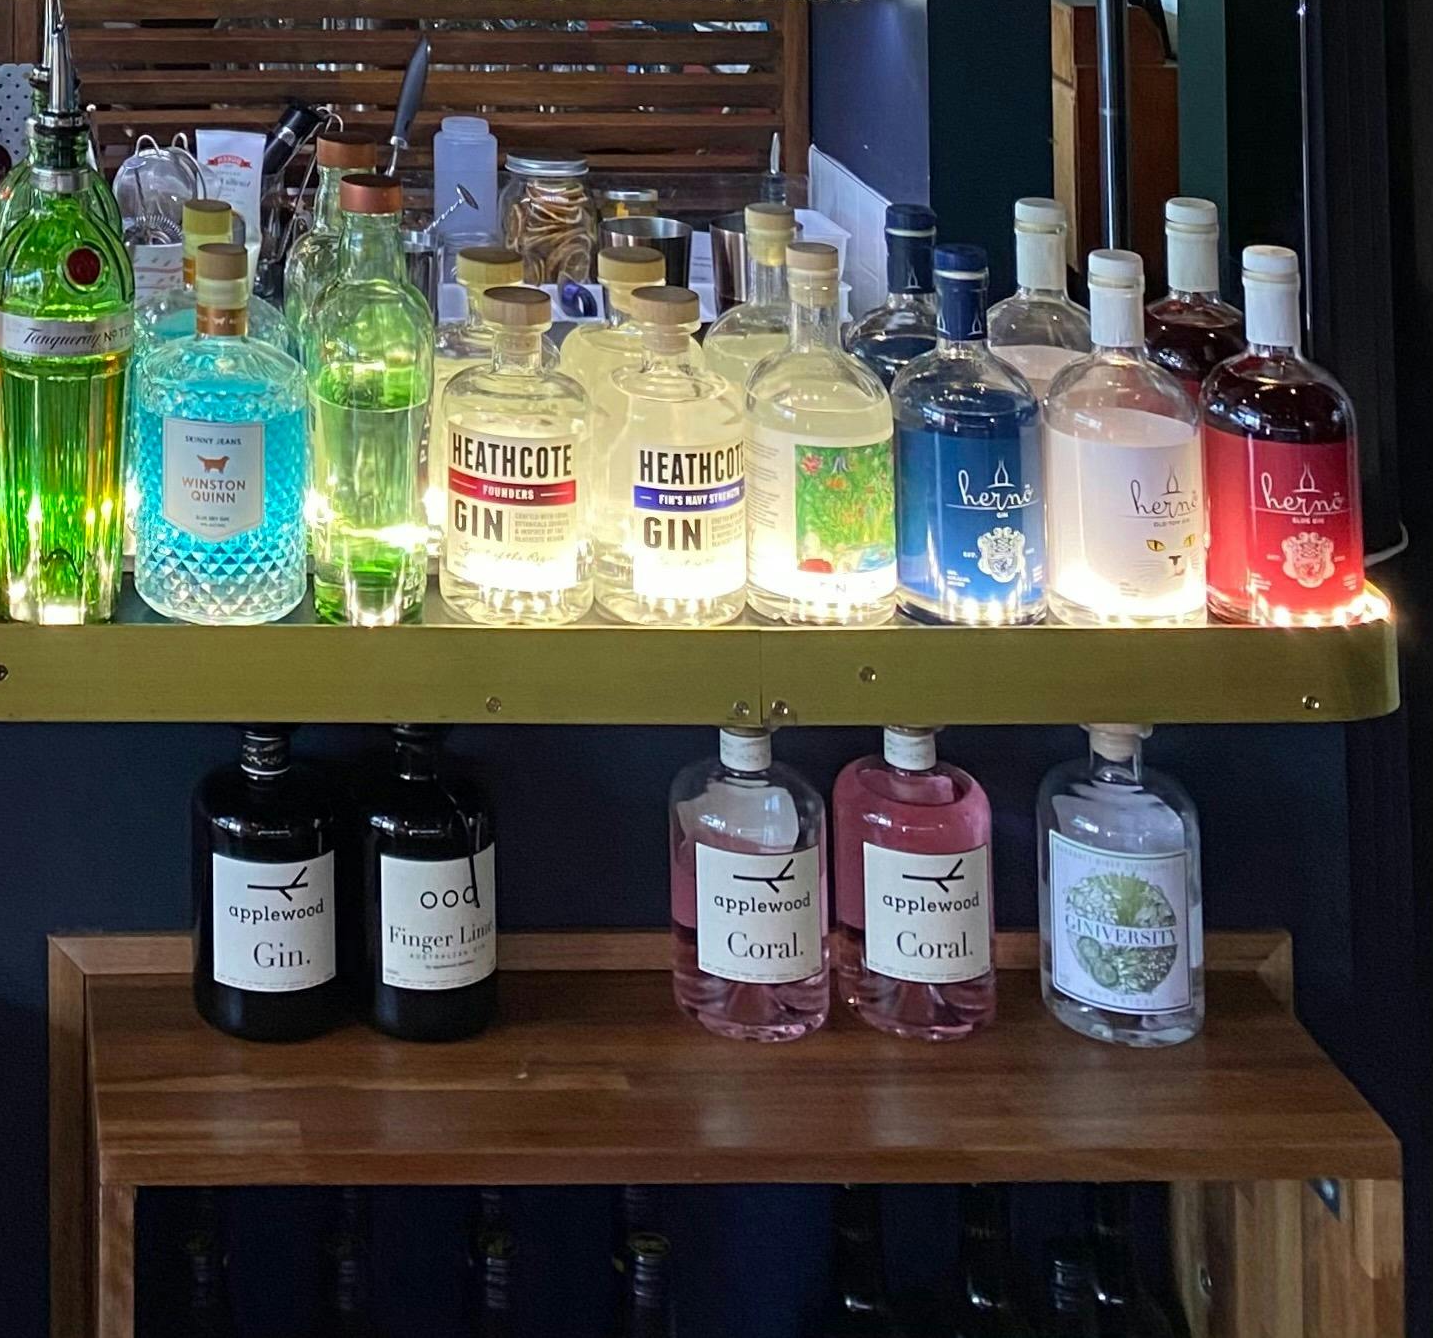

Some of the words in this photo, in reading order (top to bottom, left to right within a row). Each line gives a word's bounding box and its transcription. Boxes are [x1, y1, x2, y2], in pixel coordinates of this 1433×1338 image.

[22, 327, 103, 351] Tanqueray
[185, 435, 214, 445] SKINNY
[216, 435, 242, 446] JEANS
[452, 432, 573, 479] HEATHCOTE
[182, 476, 246, 491] WINSTON
[191, 490, 236, 504] QUINN
[482, 484, 534, 501] FOUNDERS
[958, 470, 1034, 509] hernö
[1261, 473, 1344, 513] hernö
[658, 493, 683, 506] FIN'S
[686, 494, 708, 506] NAVY
[454, 499, 504, 542] GIN
[644, 516, 702, 551] GIN
[228, 899, 325, 925] applewood
[713, 890, 811, 917] applewood
[882, 890, 980, 917] applewood
[389, 922, 453, 954] Finger
[1065, 914, 1177, 945] GINIVERSITY
[253, 942, 311, 969] Gin.
[727, 930, 805, 960] Coral.
[895, 930, 974, 960] Coral.
